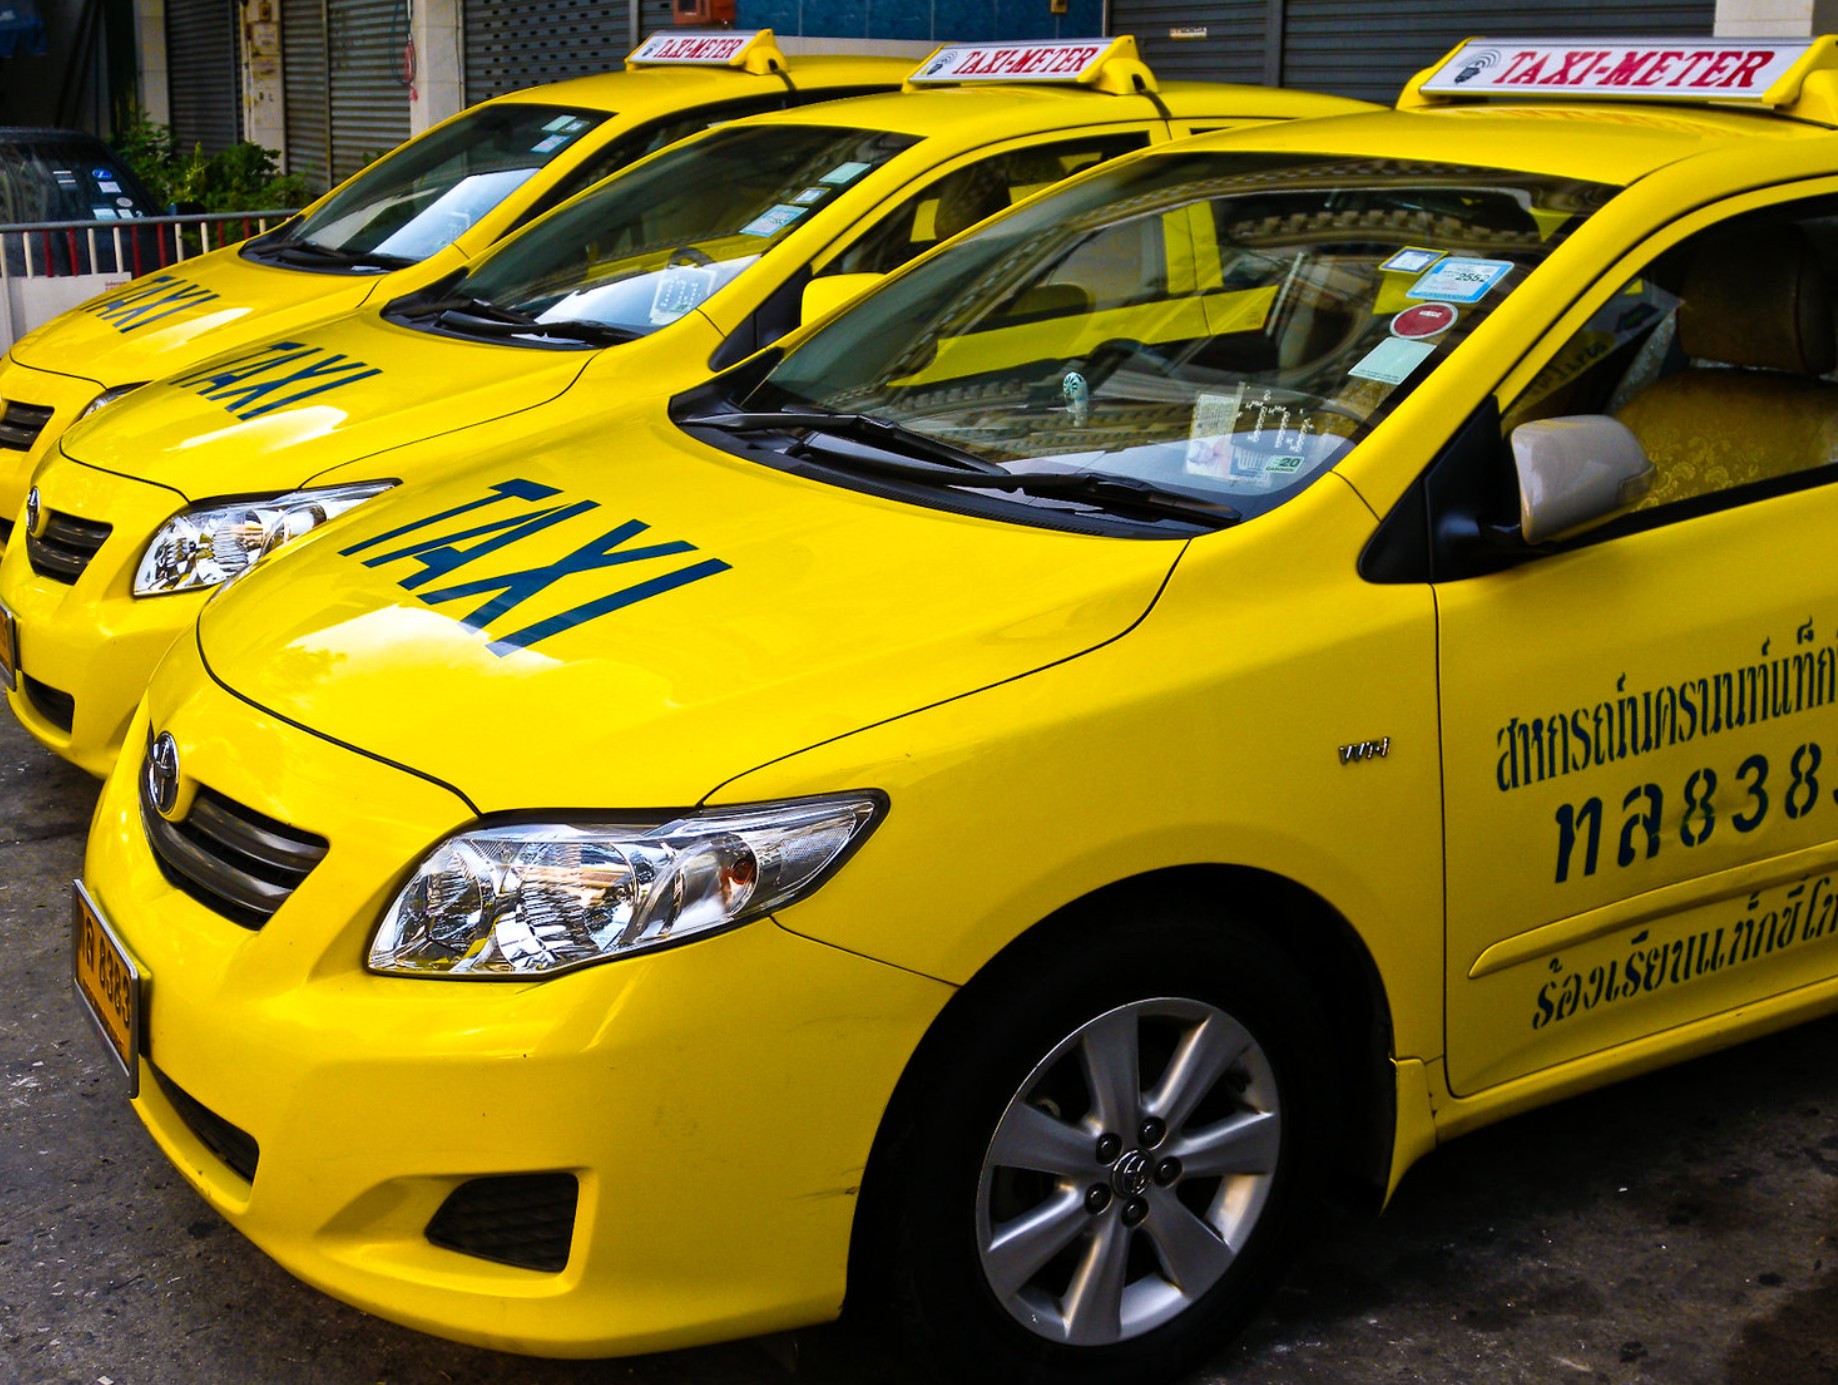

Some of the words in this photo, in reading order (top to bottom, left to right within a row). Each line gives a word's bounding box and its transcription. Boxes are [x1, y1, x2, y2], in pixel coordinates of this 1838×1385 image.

[653, 39, 744, 59] TAXI-METER
[952, 47, 1099, 74] TAXI-METER
[1492, 50, 1775, 88] TAXI-METER
[78, 275, 220, 334] TAXI
[168, 341, 384, 420] TAXI
[337, 478, 733, 658] TAXI
[1496, 615, 1838, 791] สหกรณ์นครนนท์แท็ก
[1554, 742, 1838, 884] ทล838
